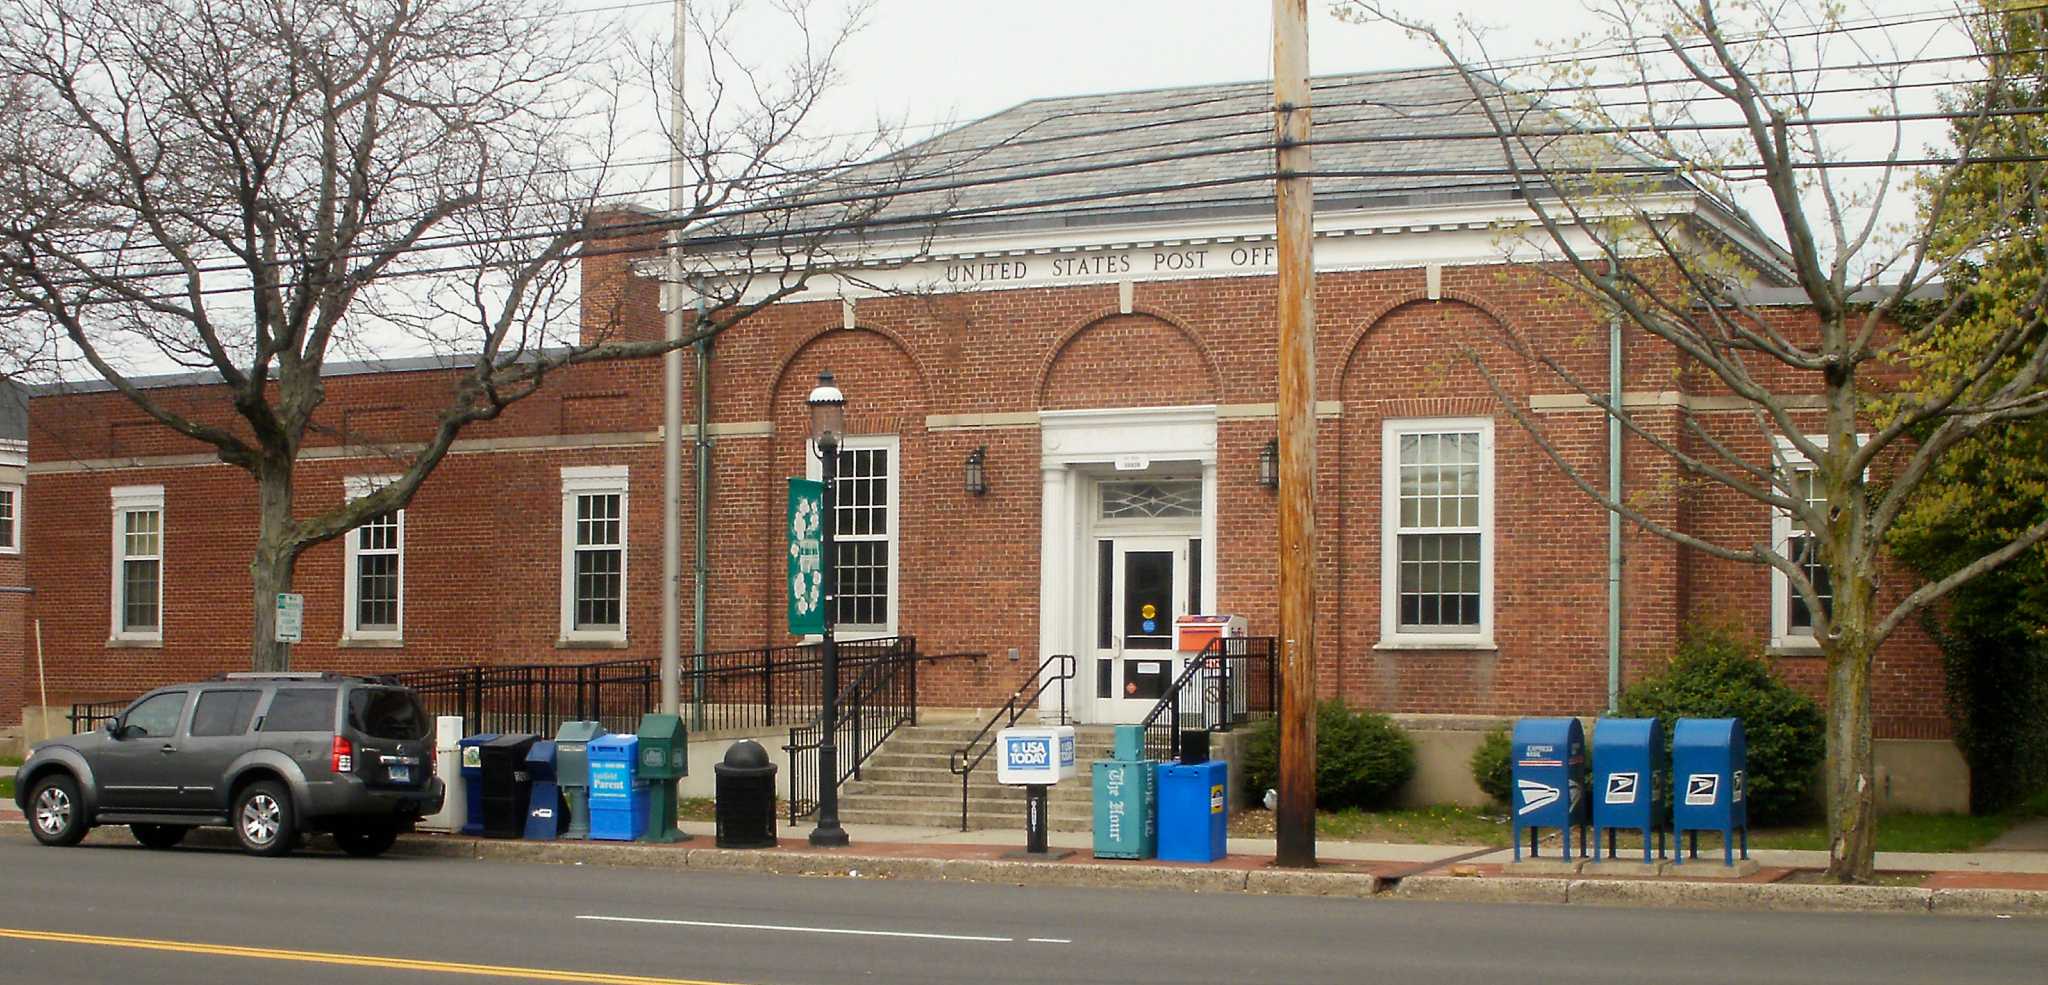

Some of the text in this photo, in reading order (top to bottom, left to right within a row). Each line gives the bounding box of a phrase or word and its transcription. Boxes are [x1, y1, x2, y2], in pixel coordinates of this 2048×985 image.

[945, 247, 1275, 283] UNITED STATES POST OFF
[1021, 741, 1046, 753] USA
[1009, 752, 1048, 765] TODAY
[593, 779, 625, 790] Parent
[1106, 767, 1125, 843] The Hour
